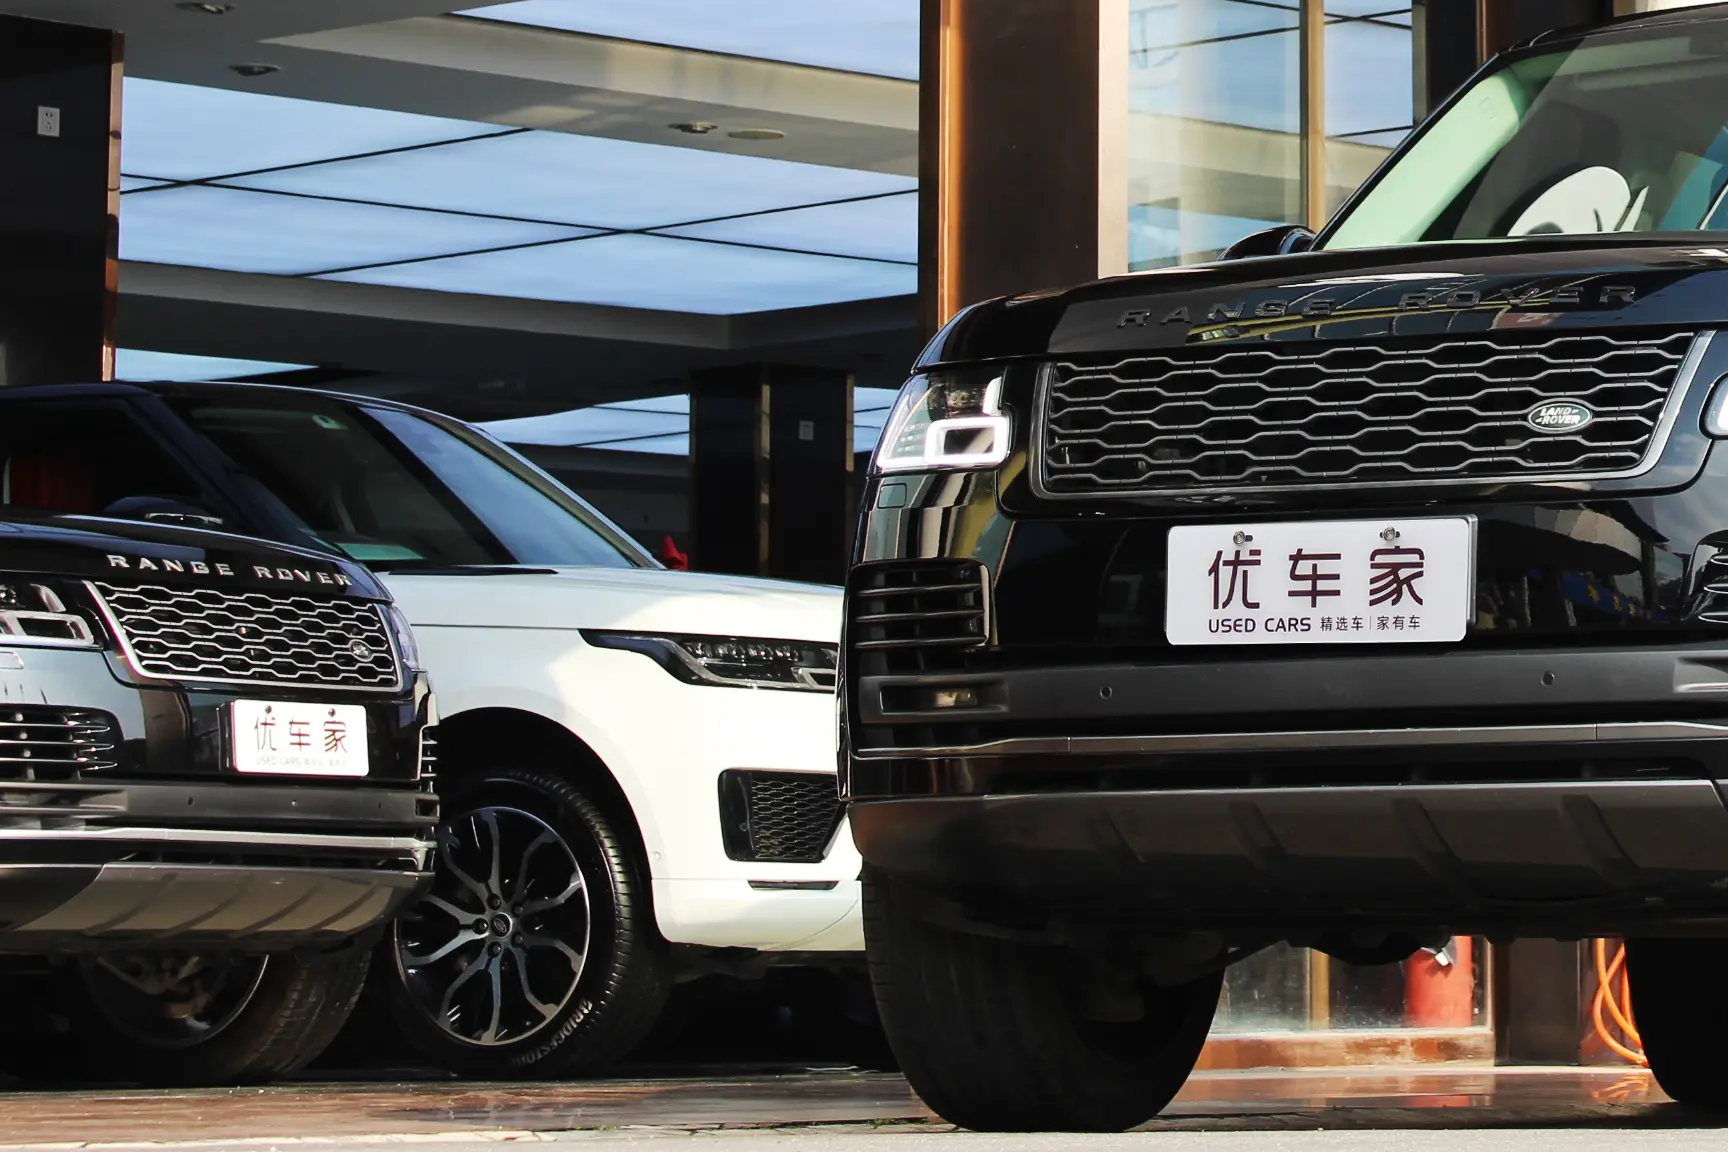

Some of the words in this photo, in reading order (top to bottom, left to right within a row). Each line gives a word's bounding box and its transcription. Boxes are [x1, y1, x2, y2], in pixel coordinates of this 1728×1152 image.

[1117, 298, 1336, 328] RANGE
[1399, 286, 1636, 312] ROVER
[106, 554, 235, 576] RANGE
[253, 565, 353, 586] ROVER
[1208, 545, 1426, 610] 优车家
[1208, 617, 1256, 633] USED
[1264, 617, 1312, 632] CARS
[254, 716, 348, 753] 优车家
[279, 757, 300, 767] CARS
